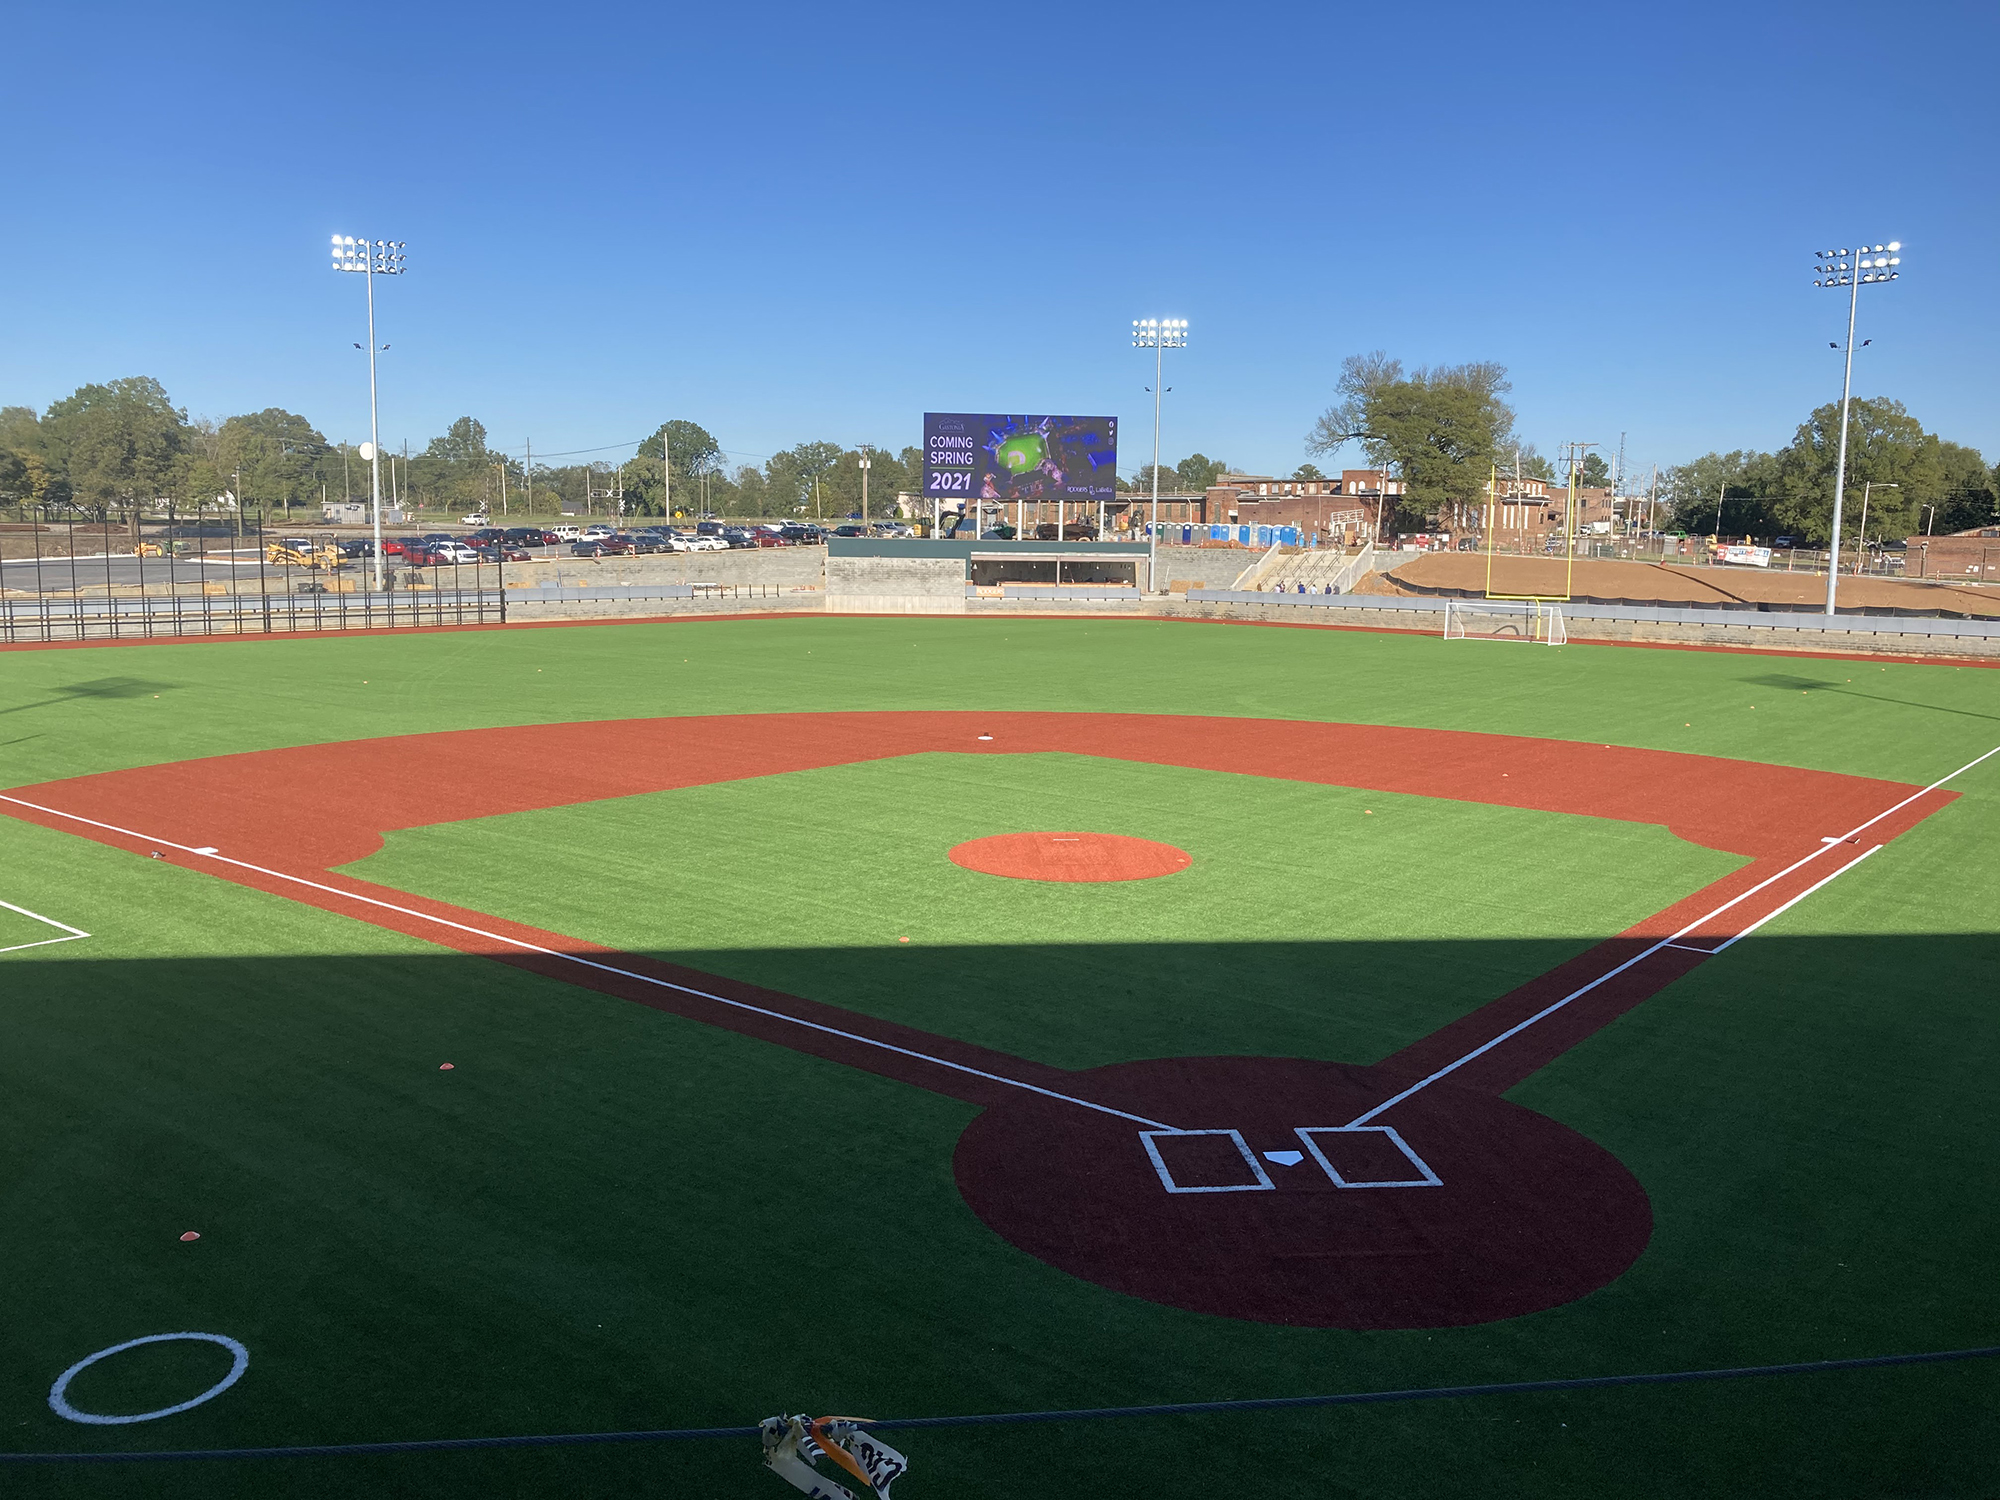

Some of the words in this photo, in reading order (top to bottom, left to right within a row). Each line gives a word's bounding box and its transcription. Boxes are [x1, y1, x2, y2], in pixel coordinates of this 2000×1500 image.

[930, 436, 973, 449] COMING
[930, 451, 973, 465] SPRING
[930, 472, 972, 490] 2021
